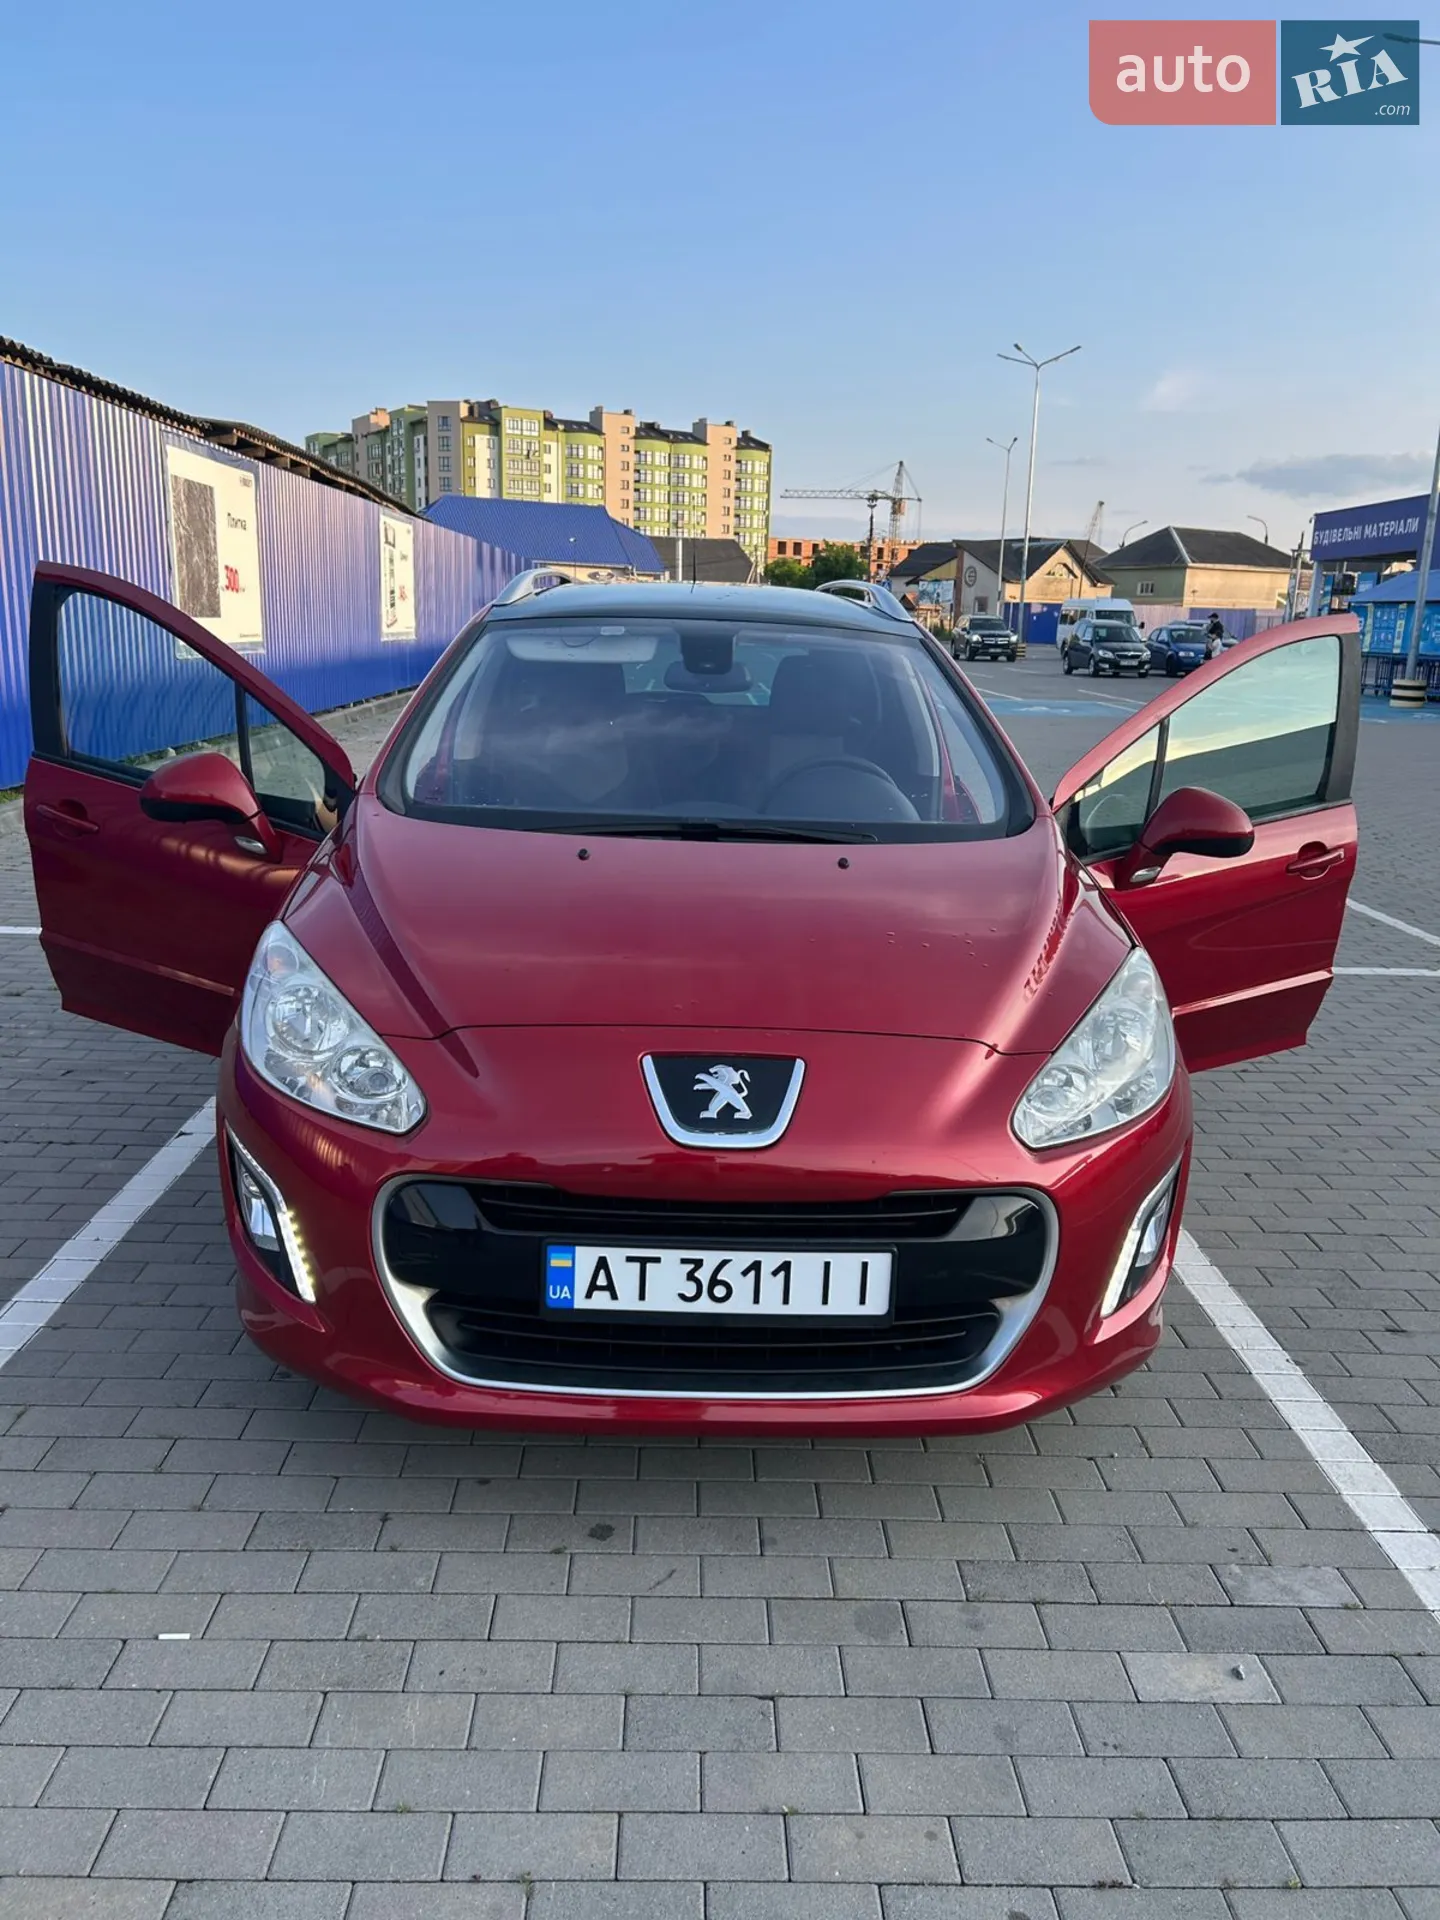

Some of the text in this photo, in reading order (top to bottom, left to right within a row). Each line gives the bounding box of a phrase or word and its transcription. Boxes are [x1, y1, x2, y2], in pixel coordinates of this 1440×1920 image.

[1313, 516, 1420, 547] БУДІВЕЛЬНІ МАТЕРІАЛИ
[549, 1285, 571, 1300] UA
[584, 1255, 662, 1302] AT
[677, 1257, 793, 1305] 3611
